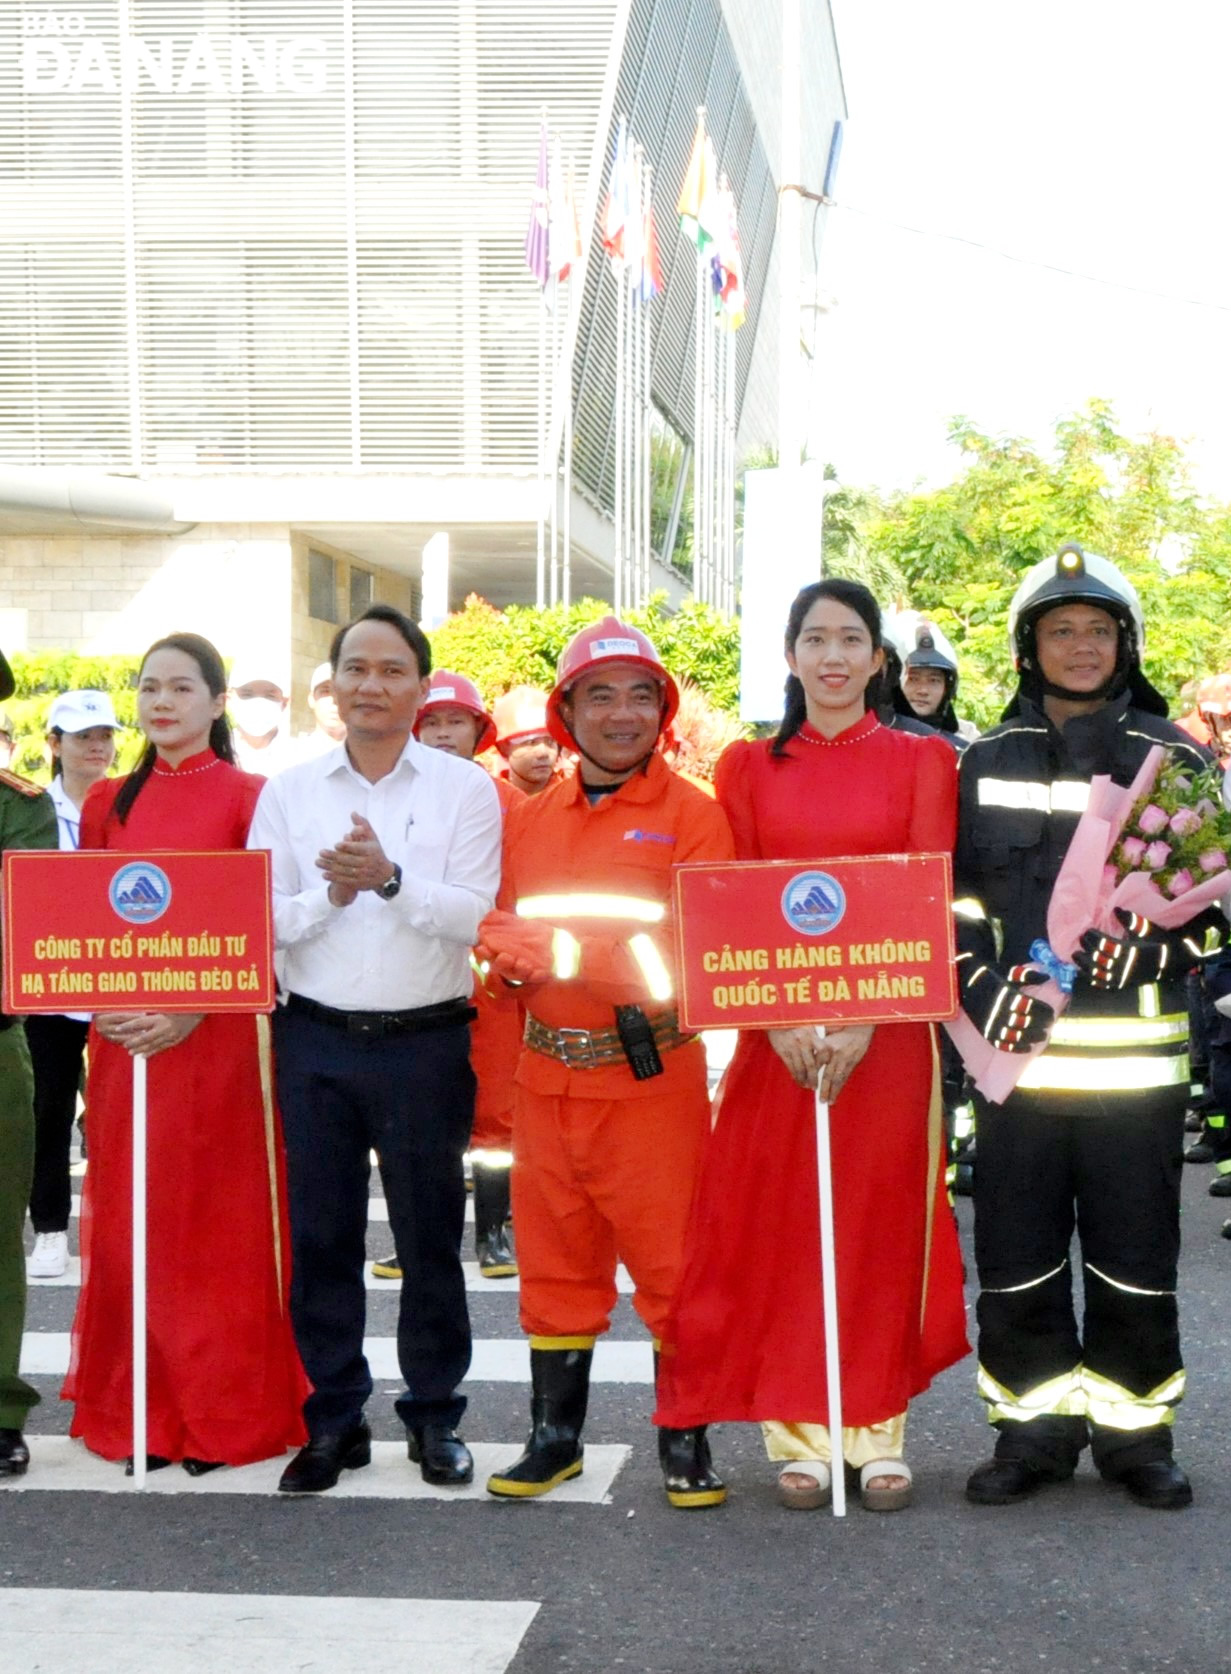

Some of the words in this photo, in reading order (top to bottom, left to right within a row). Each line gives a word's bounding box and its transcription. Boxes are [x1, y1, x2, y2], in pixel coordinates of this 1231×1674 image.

[35, 936, 81, 960] CÔNG
[86, 938, 105, 958] TY
[110, 930, 133, 957] CỔ
[137, 931, 183, 957] PHẦN
[187, 930, 220, 956] ĐẦU
[225, 934, 247, 956] TƯ
[703, 944, 769, 972] CẢNG
[776, 943, 842, 969] HÀNG
[849, 939, 931, 964] KHÔNG
[21, 973, 44, 998] HẠ
[49, 967, 93, 993] TẦNG
[98, 972, 137, 992] GIAO
[142, 968, 195, 991] THÔNG
[200, 967, 232, 990] ĐÈO
[237, 964, 259, 990] CẢ
[713, 978, 776, 1008] QUỐC
[784, 976, 811, 1003] TẾ
[818, 976, 851, 1001] ĐÀ
[858, 971, 925, 1000] NẴNG
